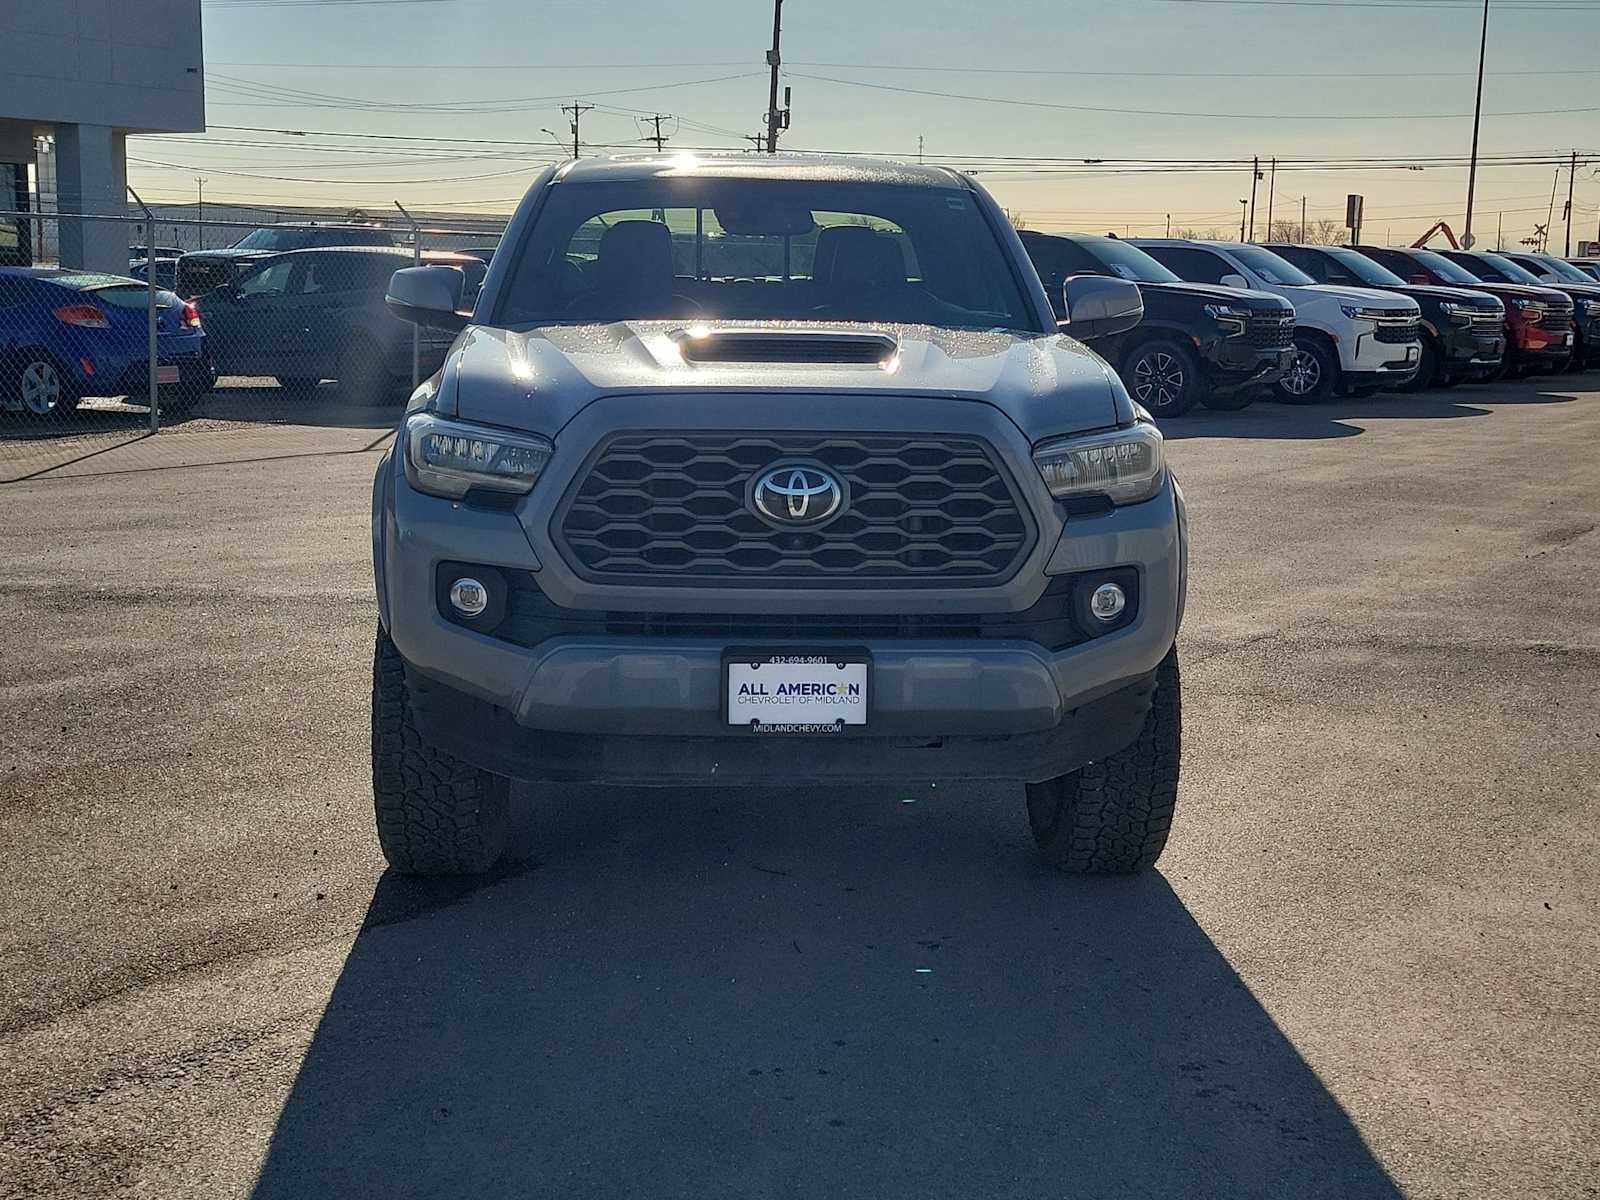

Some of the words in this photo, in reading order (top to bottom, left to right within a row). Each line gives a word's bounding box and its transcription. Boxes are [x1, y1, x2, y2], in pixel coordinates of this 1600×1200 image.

[769, 656, 827, 664] 432-694-9601
[738, 683, 768, 695] ALL
[738, 696, 795, 704] CHEVROLET
[799, 696, 811, 704] OF
[815, 696, 859, 704] MIDLAND
[753, 724, 841, 733] MIDLANDCHEVY.COM
